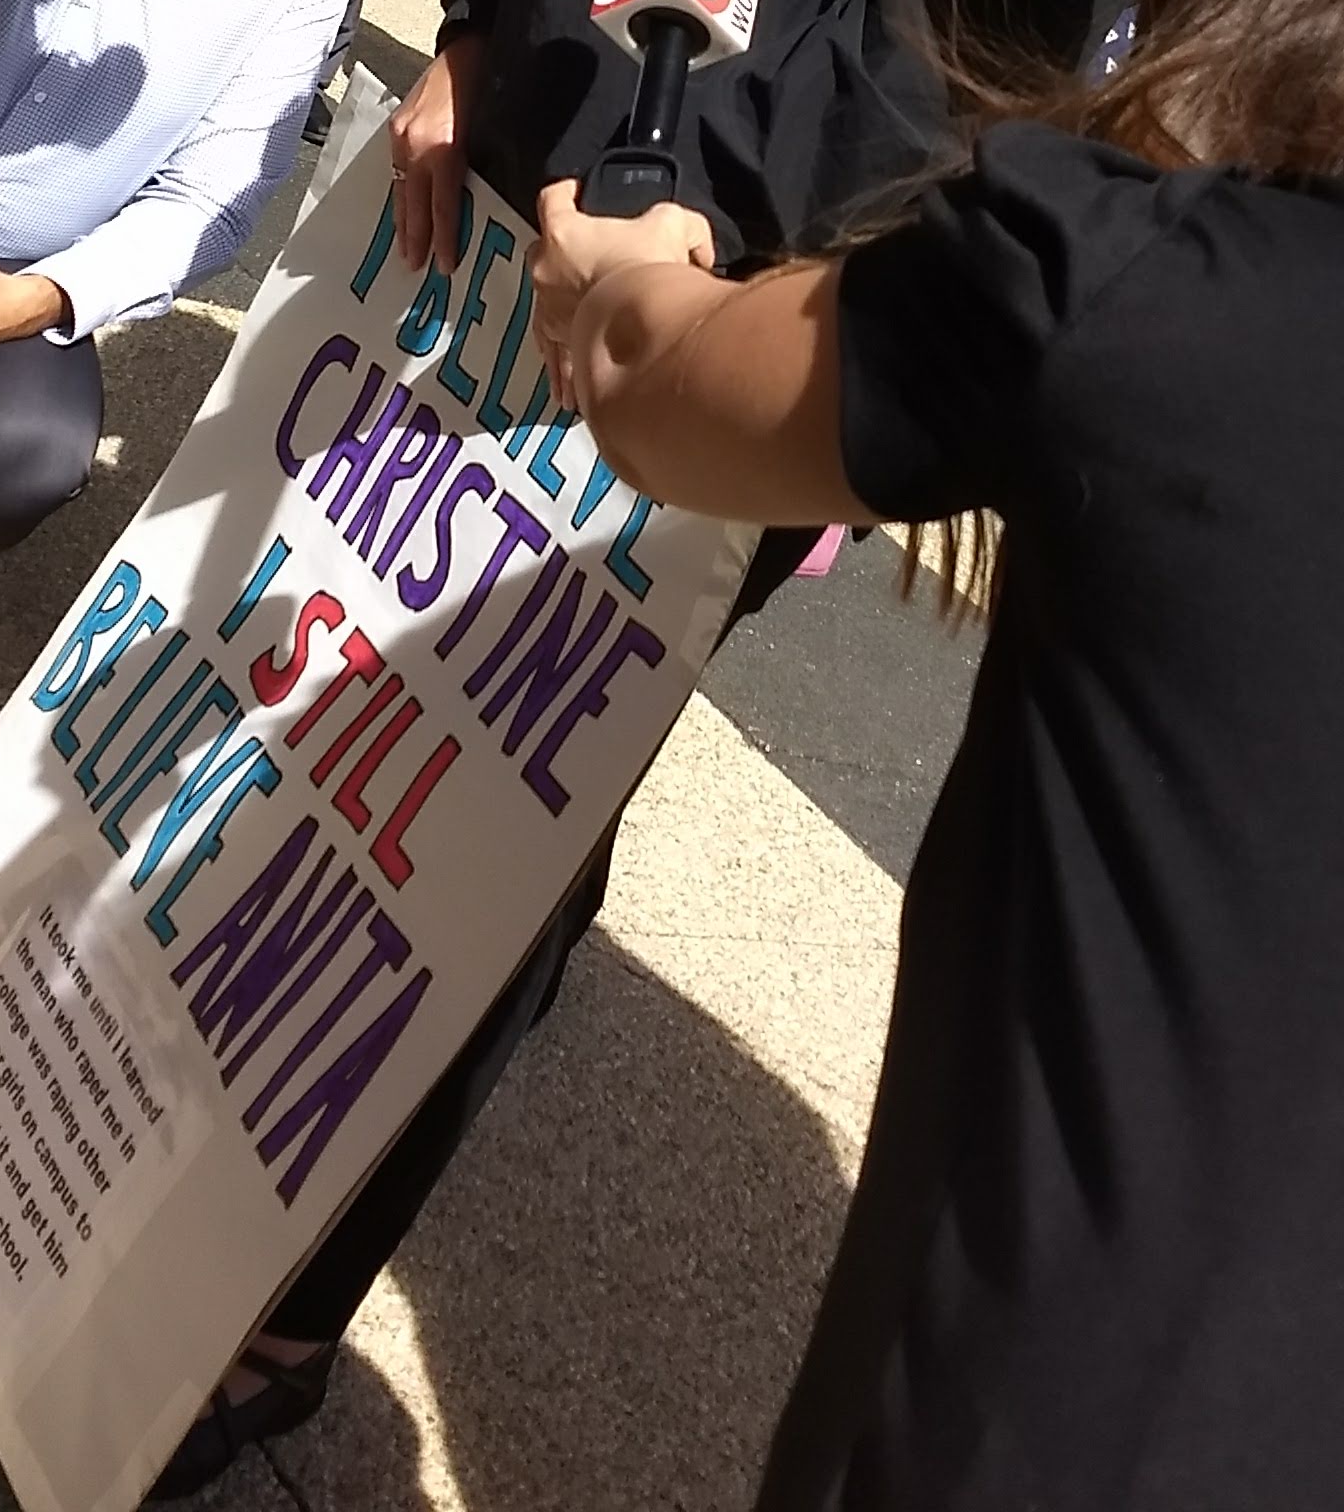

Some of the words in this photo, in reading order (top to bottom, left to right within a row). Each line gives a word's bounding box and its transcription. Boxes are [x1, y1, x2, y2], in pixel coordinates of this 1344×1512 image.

[217, 533, 293, 644] I
[275, 333, 666, 818] CHRISTINE
[249, 589, 462, 891] STILL
[30, 559, 283, 949] BELIEVE
[169, 813, 433, 1210] ANITA
[39, 903, 53, 930] It
[47, 922, 76, 970] took
[71, 964, 93, 1000] me
[15, 936, 35, 973] the
[30, 968, 57, 1014] man
[54, 1007, 80, 1054] who
[74, 1048, 111, 1109] raped
[100, 1103, 124, 1141] me
[118, 1132, 137, 1165] in
[87, 994, 120, 1044] until
[111, 1034, 125, 1055] I
[26, 1035, 53, 1082] was
[46, 1076, 82, 1145] raping
[76, 1137, 112, 1196] other
[116, 1045, 166, 1127] learned
[3, 1158, 32, 1202] and
[20, 1197, 50, 1239] get
[40, 1229, 70, 1280] him
[20, 1109, 39, 1140] on
[33, 1136, 80, 1218] campus
[74, 1211, 93, 1243] to
